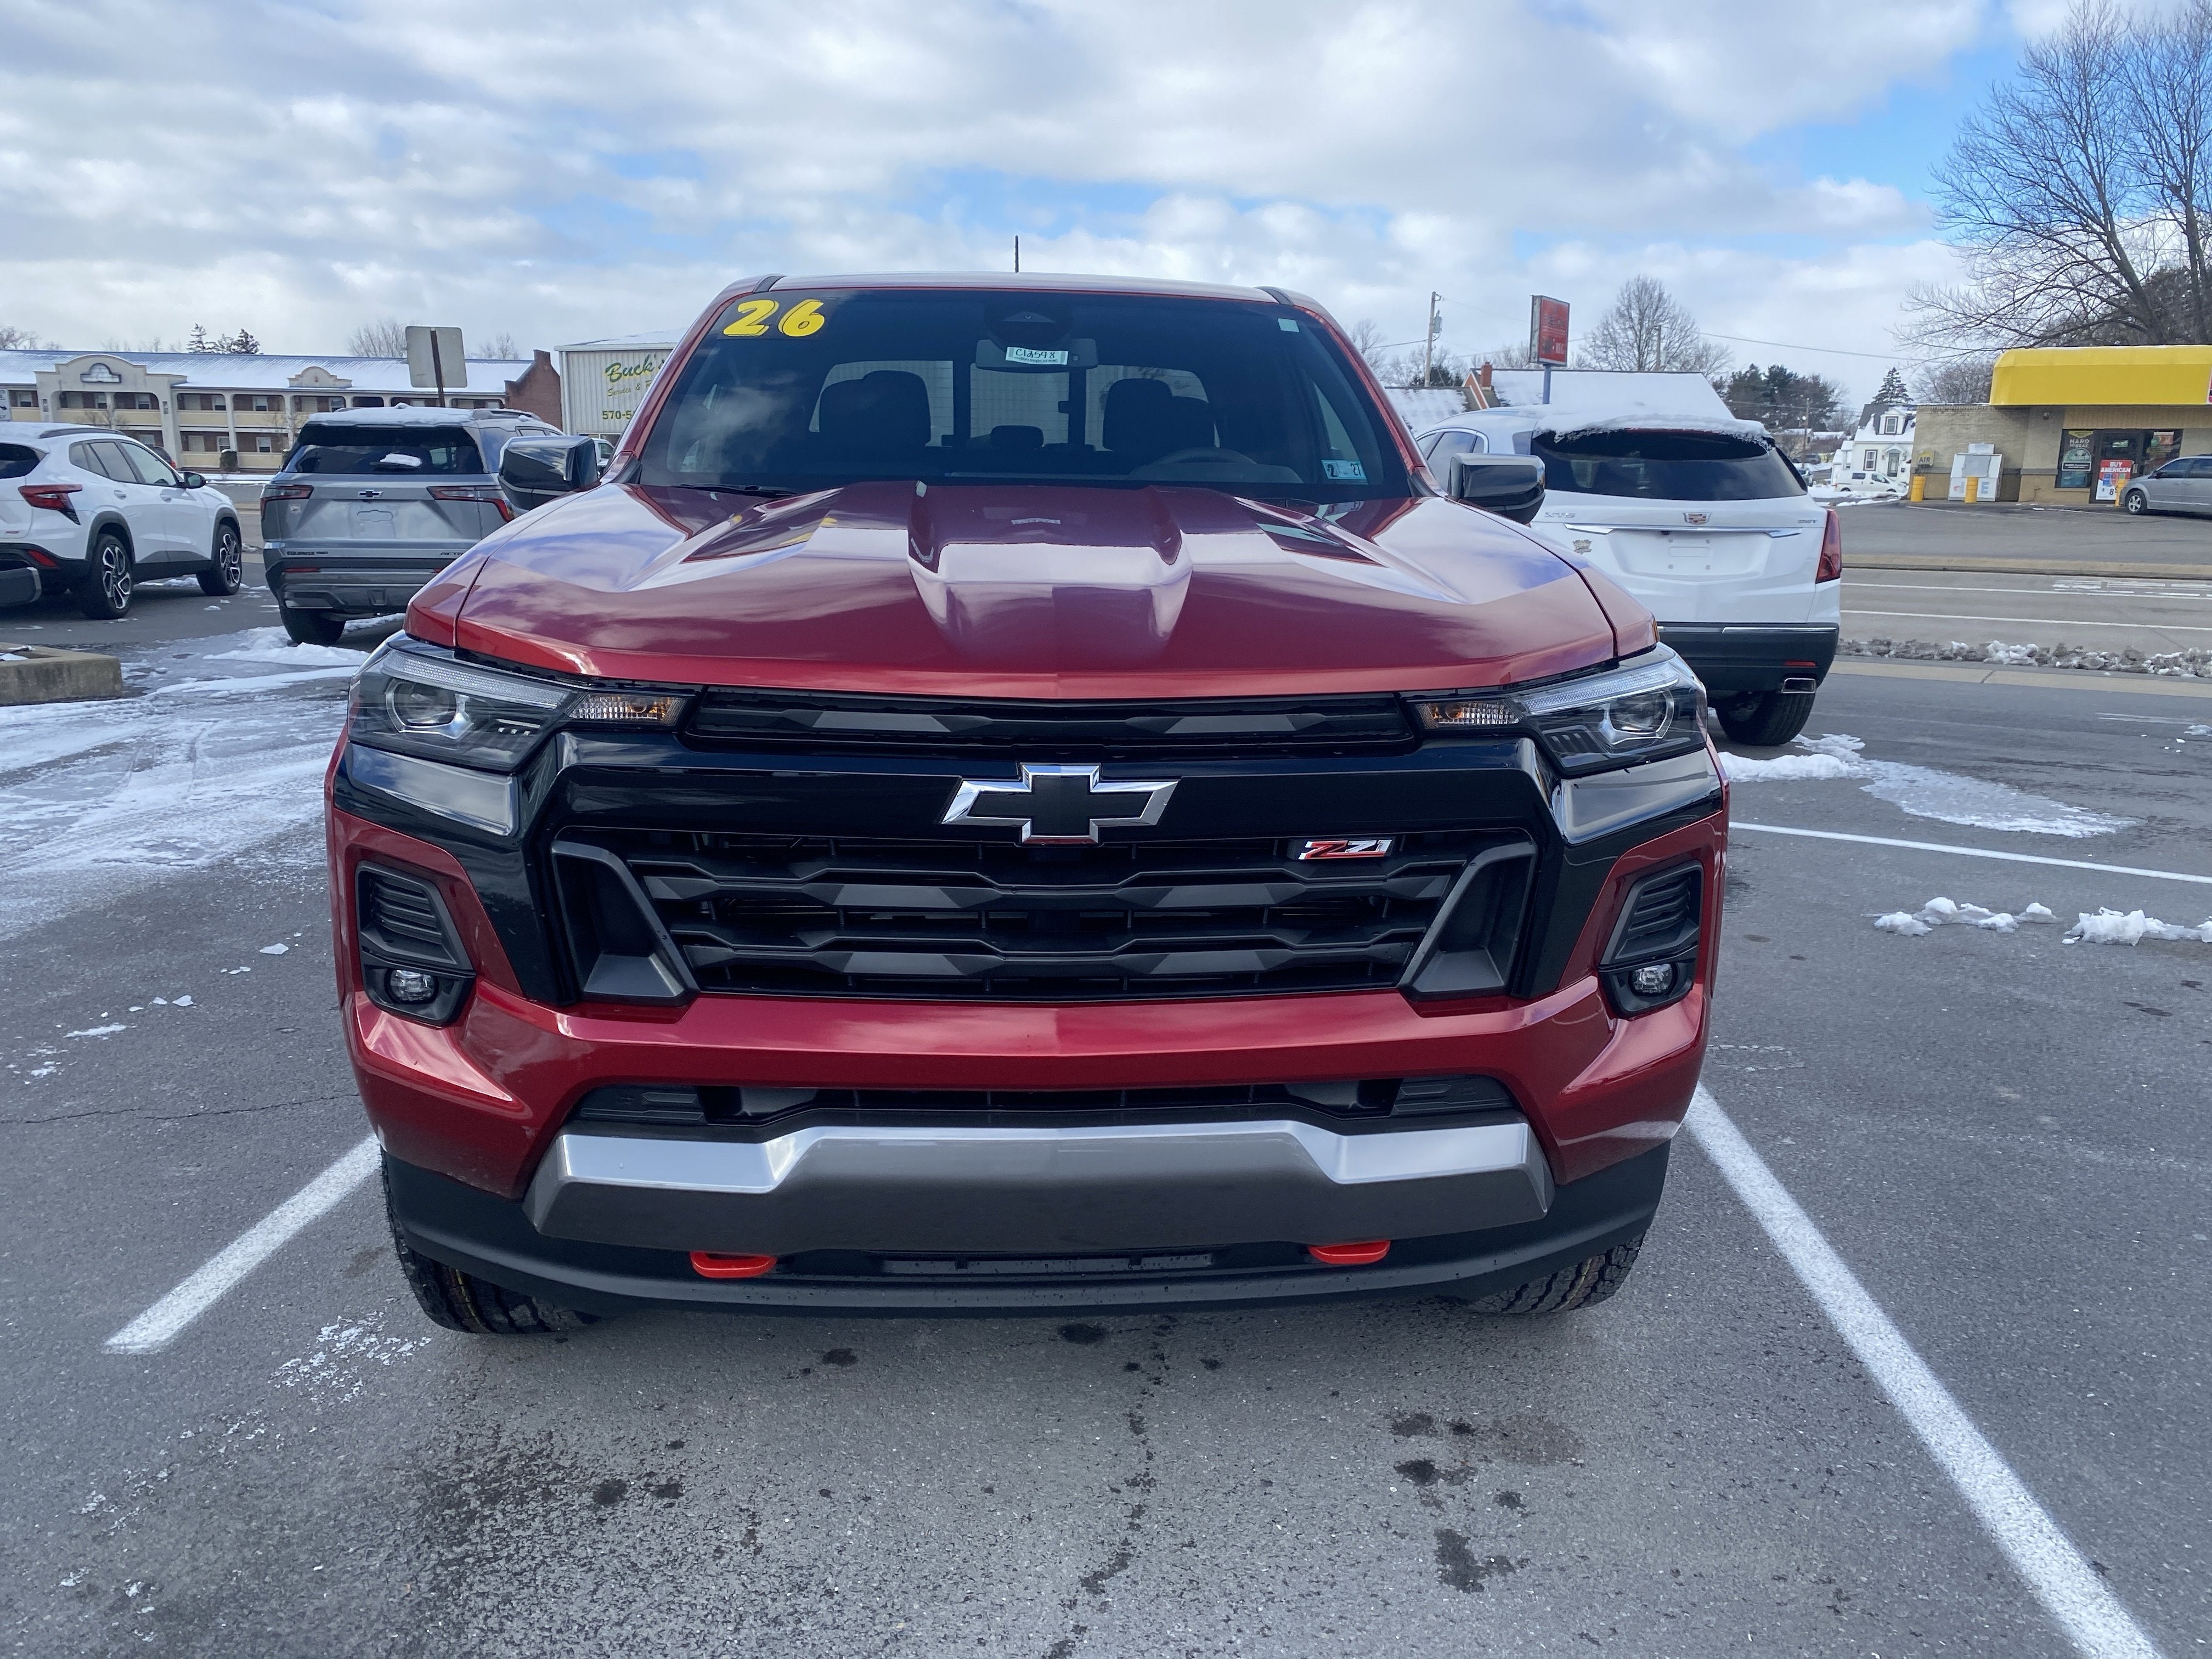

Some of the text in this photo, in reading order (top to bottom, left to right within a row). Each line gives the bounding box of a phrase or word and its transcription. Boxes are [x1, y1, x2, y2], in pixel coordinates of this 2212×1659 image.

[723, 298, 825, 337] 26
[602, 410, 635, 420] 570-5
[1298, 839, 1392, 860] Z71
